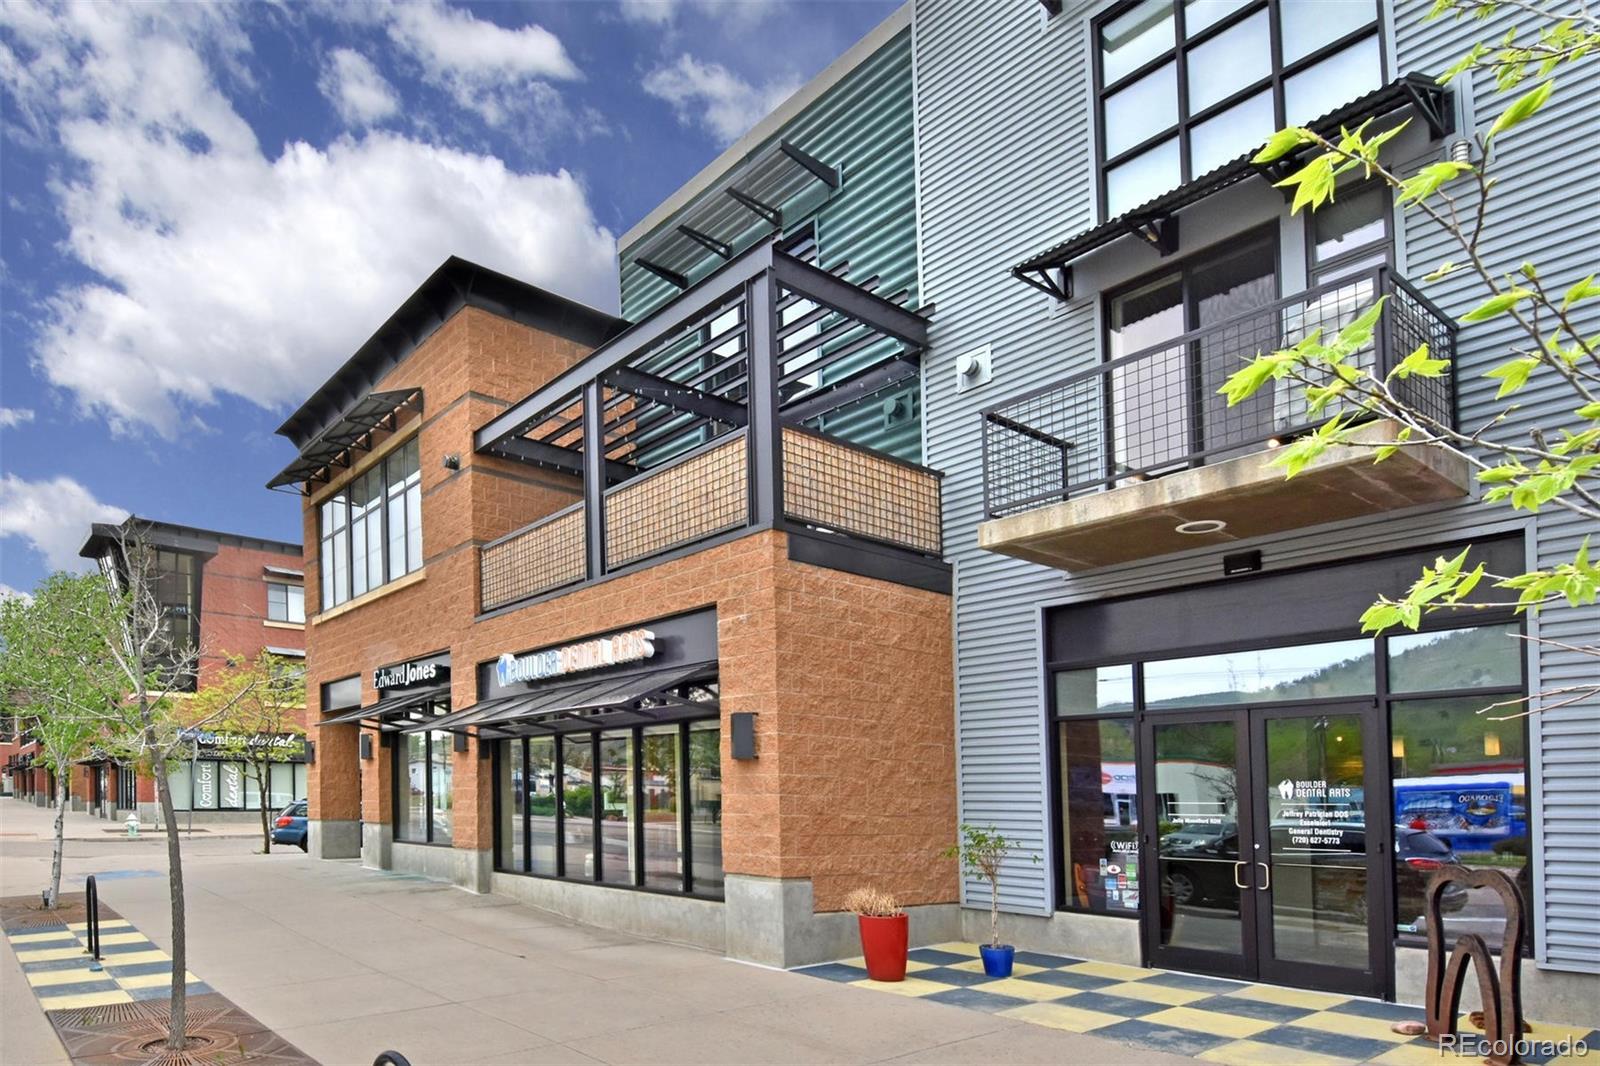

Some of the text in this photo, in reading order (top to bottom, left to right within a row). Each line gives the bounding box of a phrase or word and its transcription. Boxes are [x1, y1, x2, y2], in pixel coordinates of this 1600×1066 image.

[1295, 780, 1327, 788] BOULDER
[1295, 788, 1351, 798] DENTAL ARTS
[1282, 810, 1304, 819] Jeffrey
[1288, 827, 1344, 837] General Dentistry
